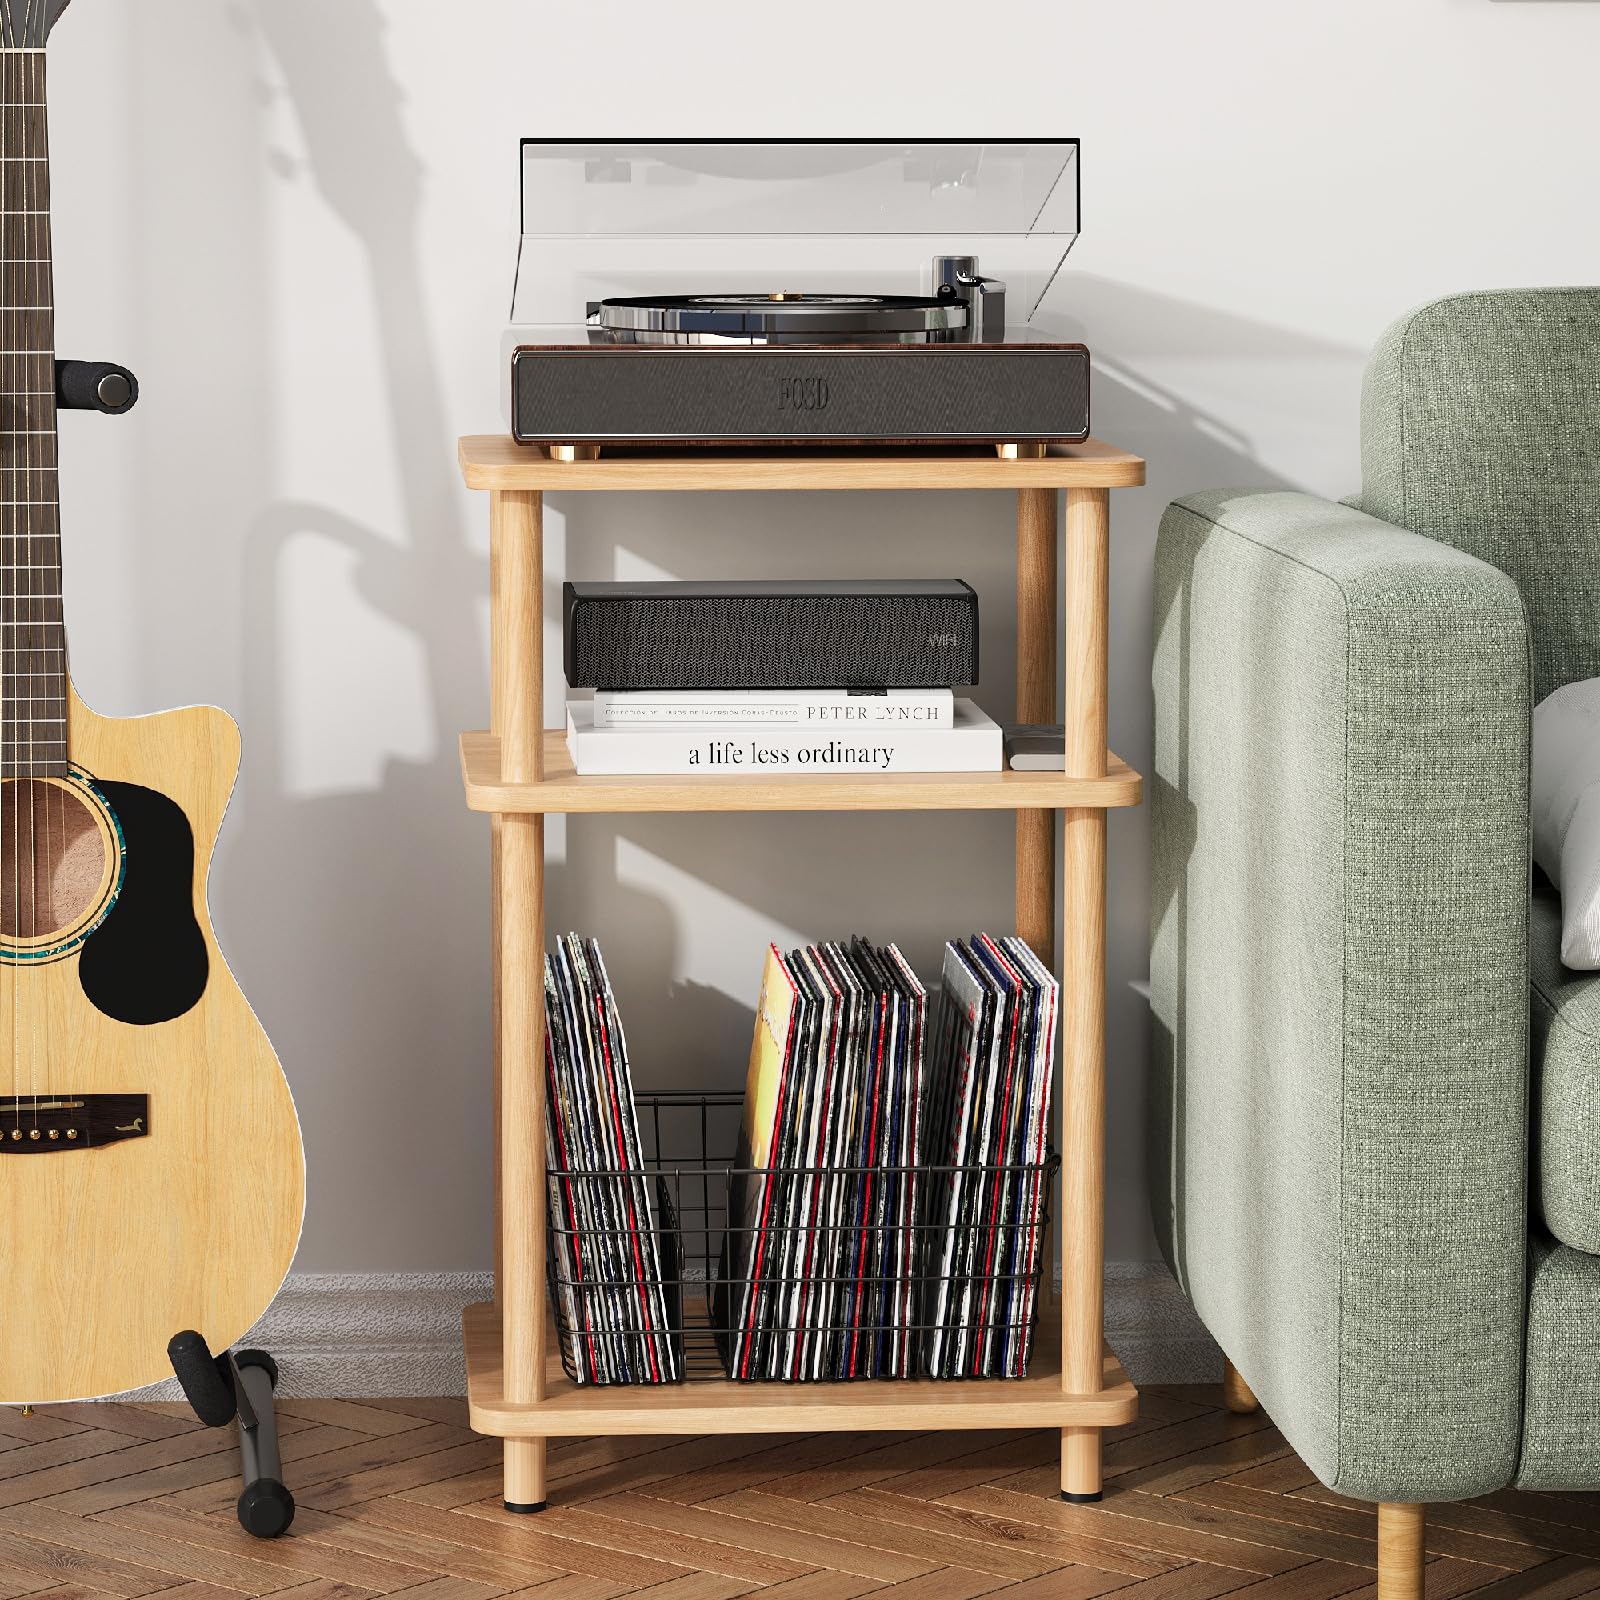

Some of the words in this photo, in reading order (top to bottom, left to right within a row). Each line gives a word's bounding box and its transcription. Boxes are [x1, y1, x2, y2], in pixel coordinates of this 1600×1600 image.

[806, 706, 869, 720] PETER
[875, 706, 939, 720] LYNCH
[689, 749, 700, 764] a
[709, 741, 743, 764] life
[751, 742, 790, 764] less
[797, 741, 895, 768] ordinary
